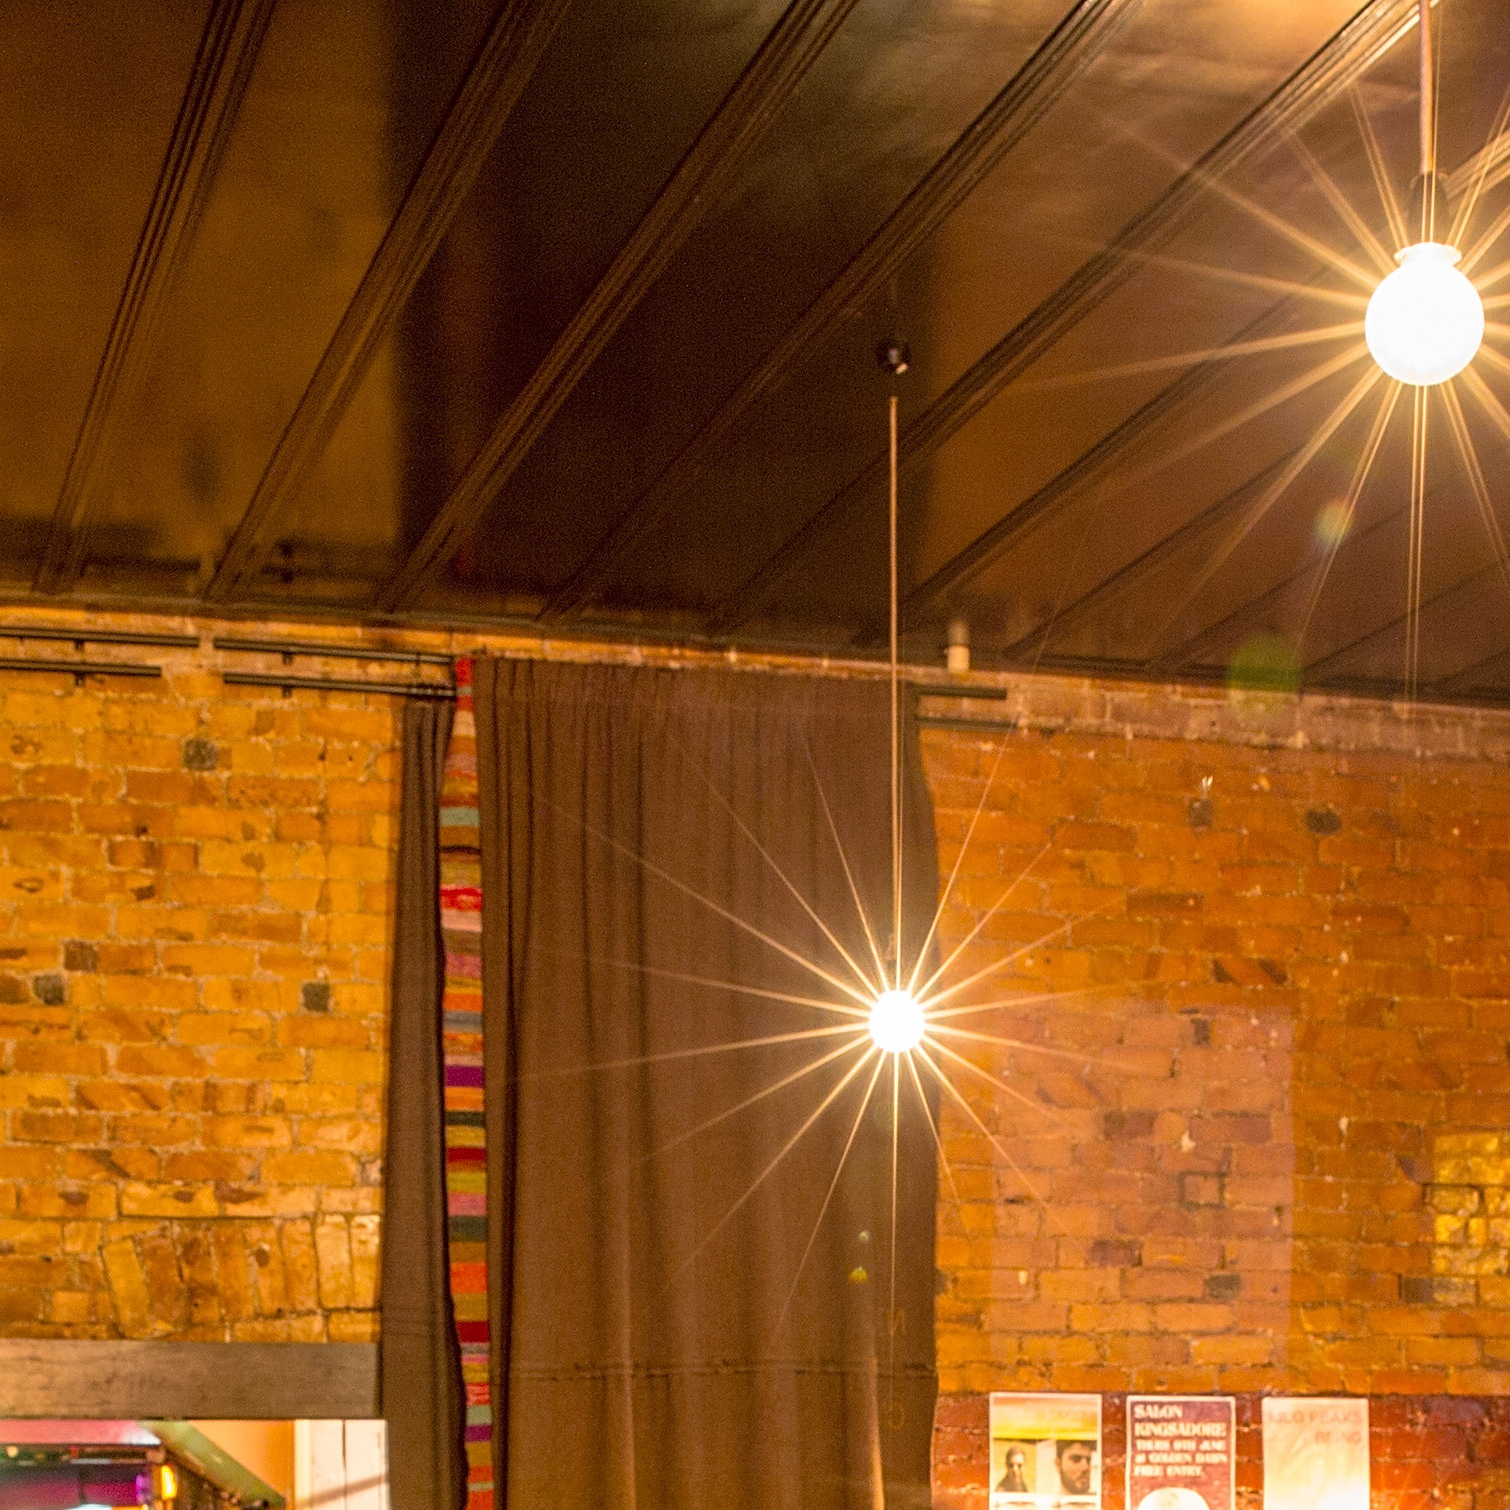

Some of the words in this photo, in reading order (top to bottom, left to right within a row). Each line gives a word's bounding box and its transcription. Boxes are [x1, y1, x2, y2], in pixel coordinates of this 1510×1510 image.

[1134, 1404, 1183, 1419] SALON
[1134, 1422, 1227, 1437] KINGSADORE
[1148, 1452, 1193, 1464] GOLDEN
[1134, 1465, 1164, 1477] FREE
